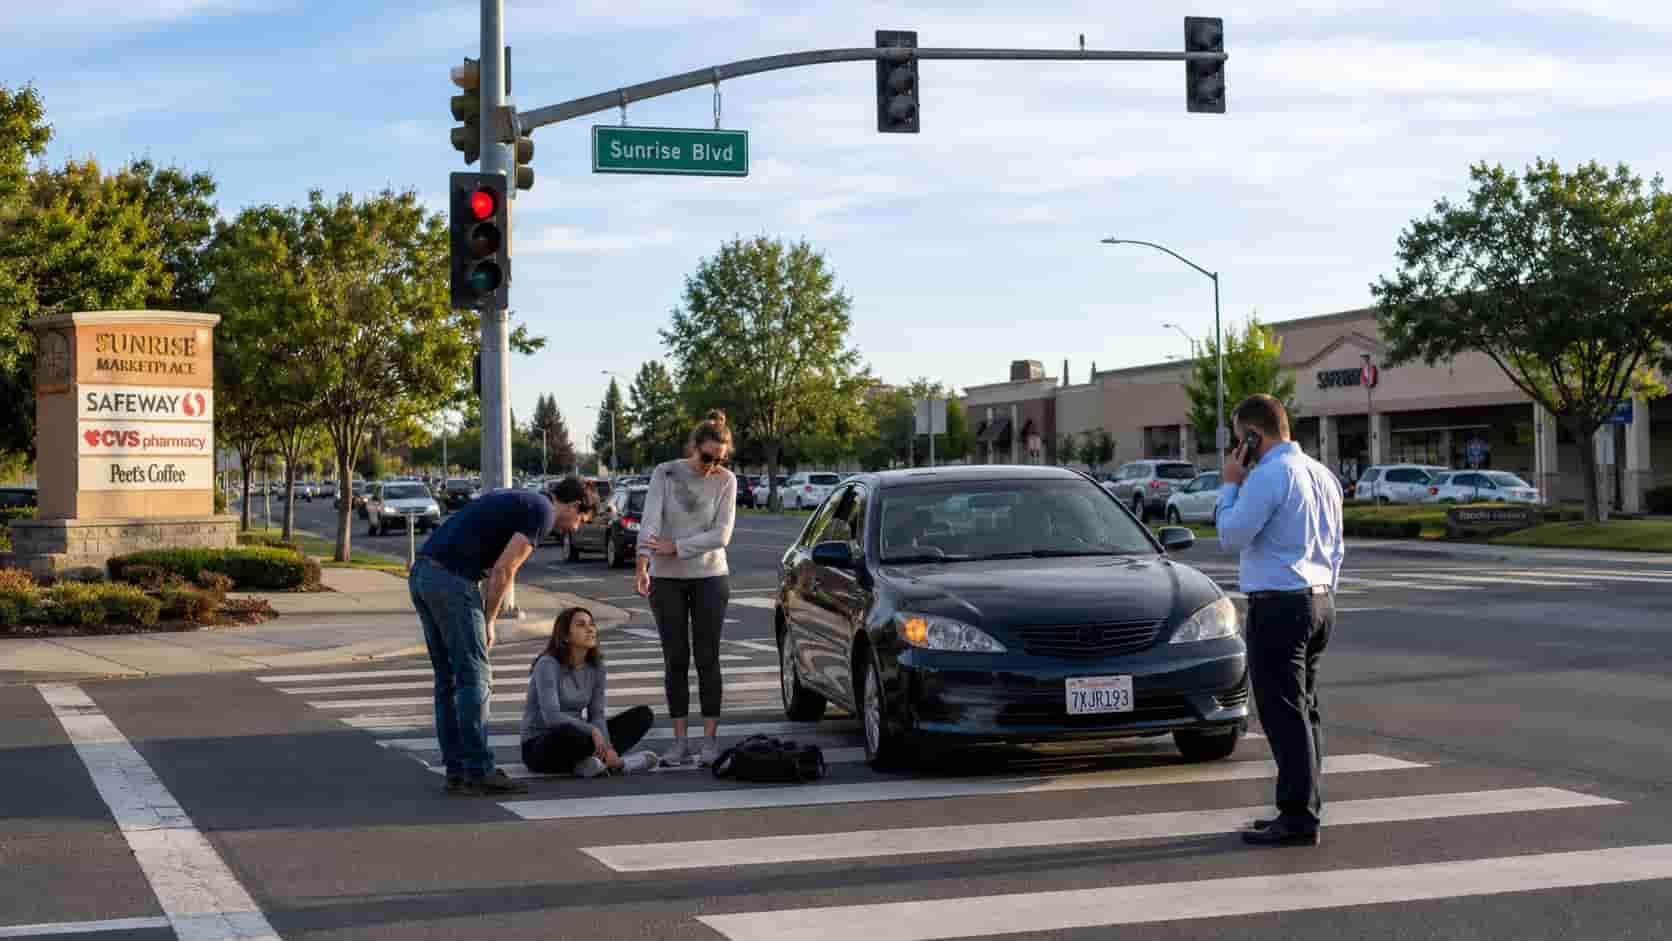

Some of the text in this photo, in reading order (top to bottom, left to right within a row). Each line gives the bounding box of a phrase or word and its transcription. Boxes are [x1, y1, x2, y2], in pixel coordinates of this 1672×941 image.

[610, 140, 733, 161] Sunrise Blvd
[96, 332, 196, 357] SUNRISE
[96, 358, 196, 375] MARKETPLACE
[86, 392, 180, 413] SAFEWAY
[101, 429, 206, 450] CVS pharmacy
[109, 463, 186, 483] Peet's Coffee
